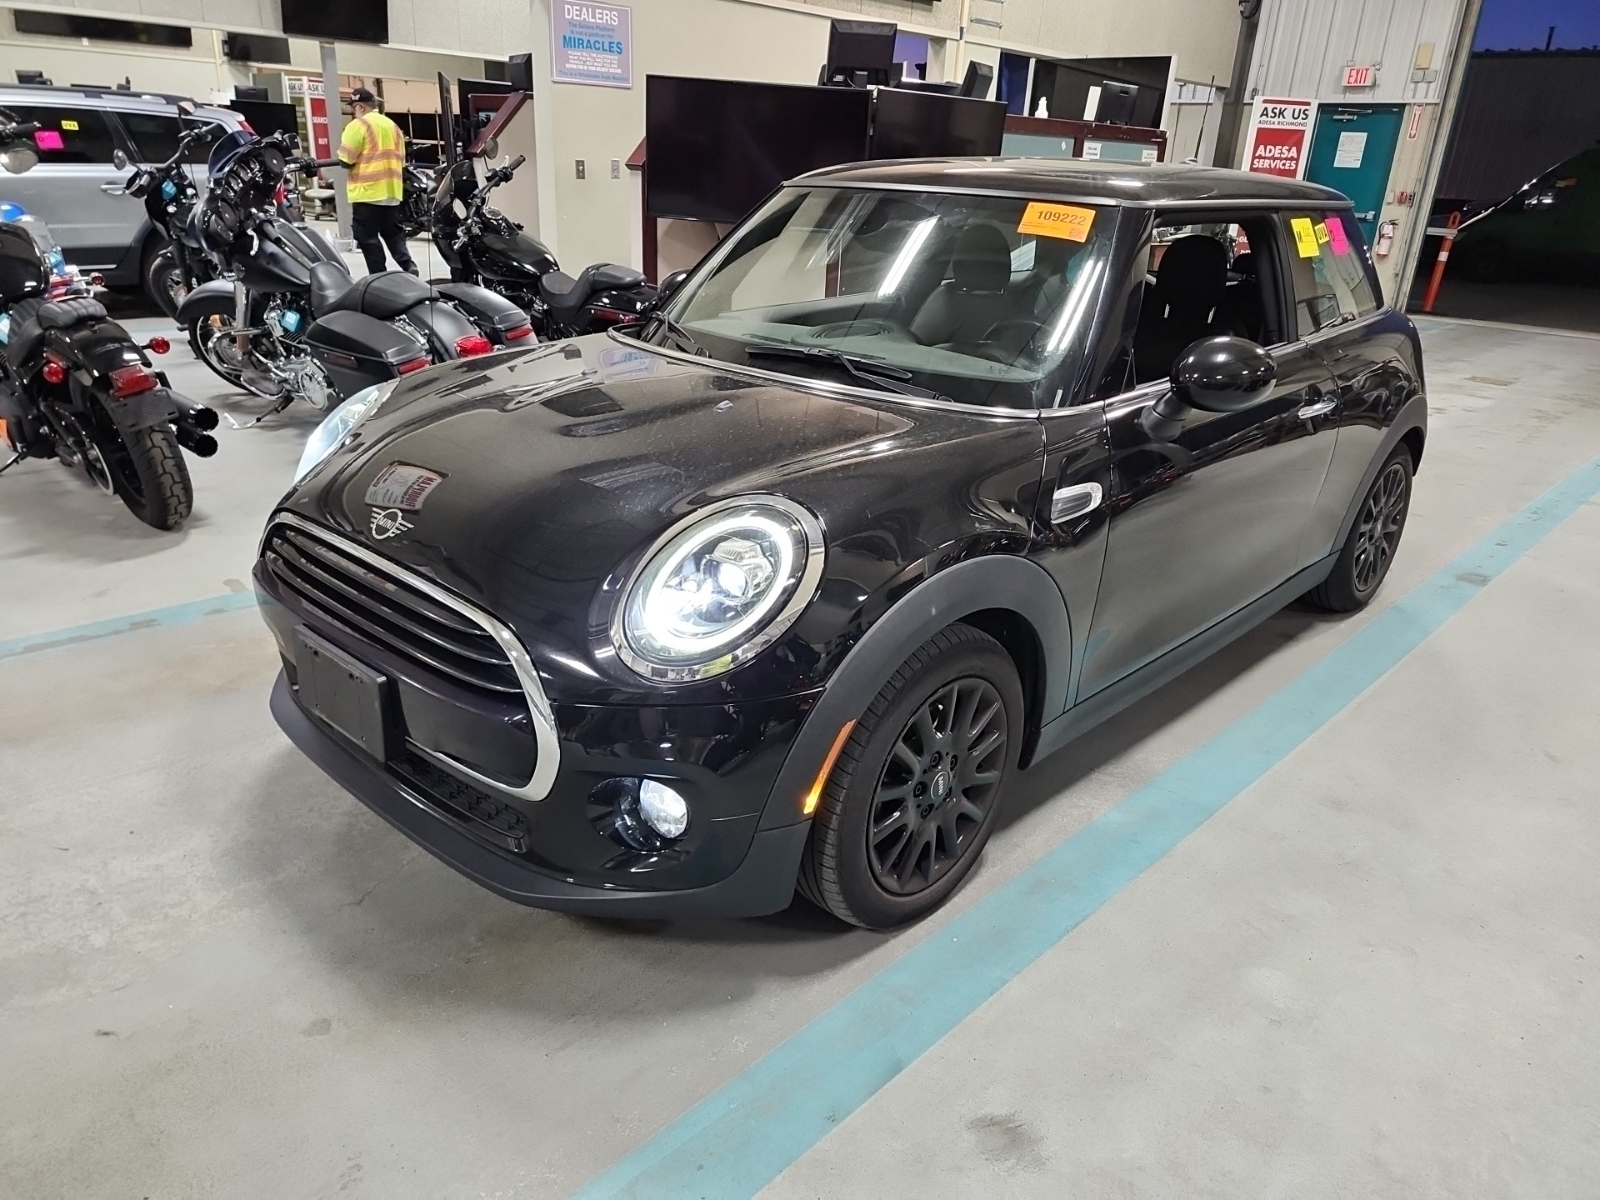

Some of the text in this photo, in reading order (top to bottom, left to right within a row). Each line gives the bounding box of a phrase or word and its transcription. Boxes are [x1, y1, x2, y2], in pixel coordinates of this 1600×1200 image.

[565, 4, 618, 25] DEALERS
[563, 35, 622, 54] MIRACLES
[1347, 68, 1370, 84] EXIT
[309, 83, 319, 92] ASK
[1260, 107, 1309, 120] ASK US
[1255, 145, 1298, 158] ADESA
[1253, 159, 1296, 169] SERVICES
[1037, 210, 1087, 226] 109222
[376, 516, 395, 530] MINI
